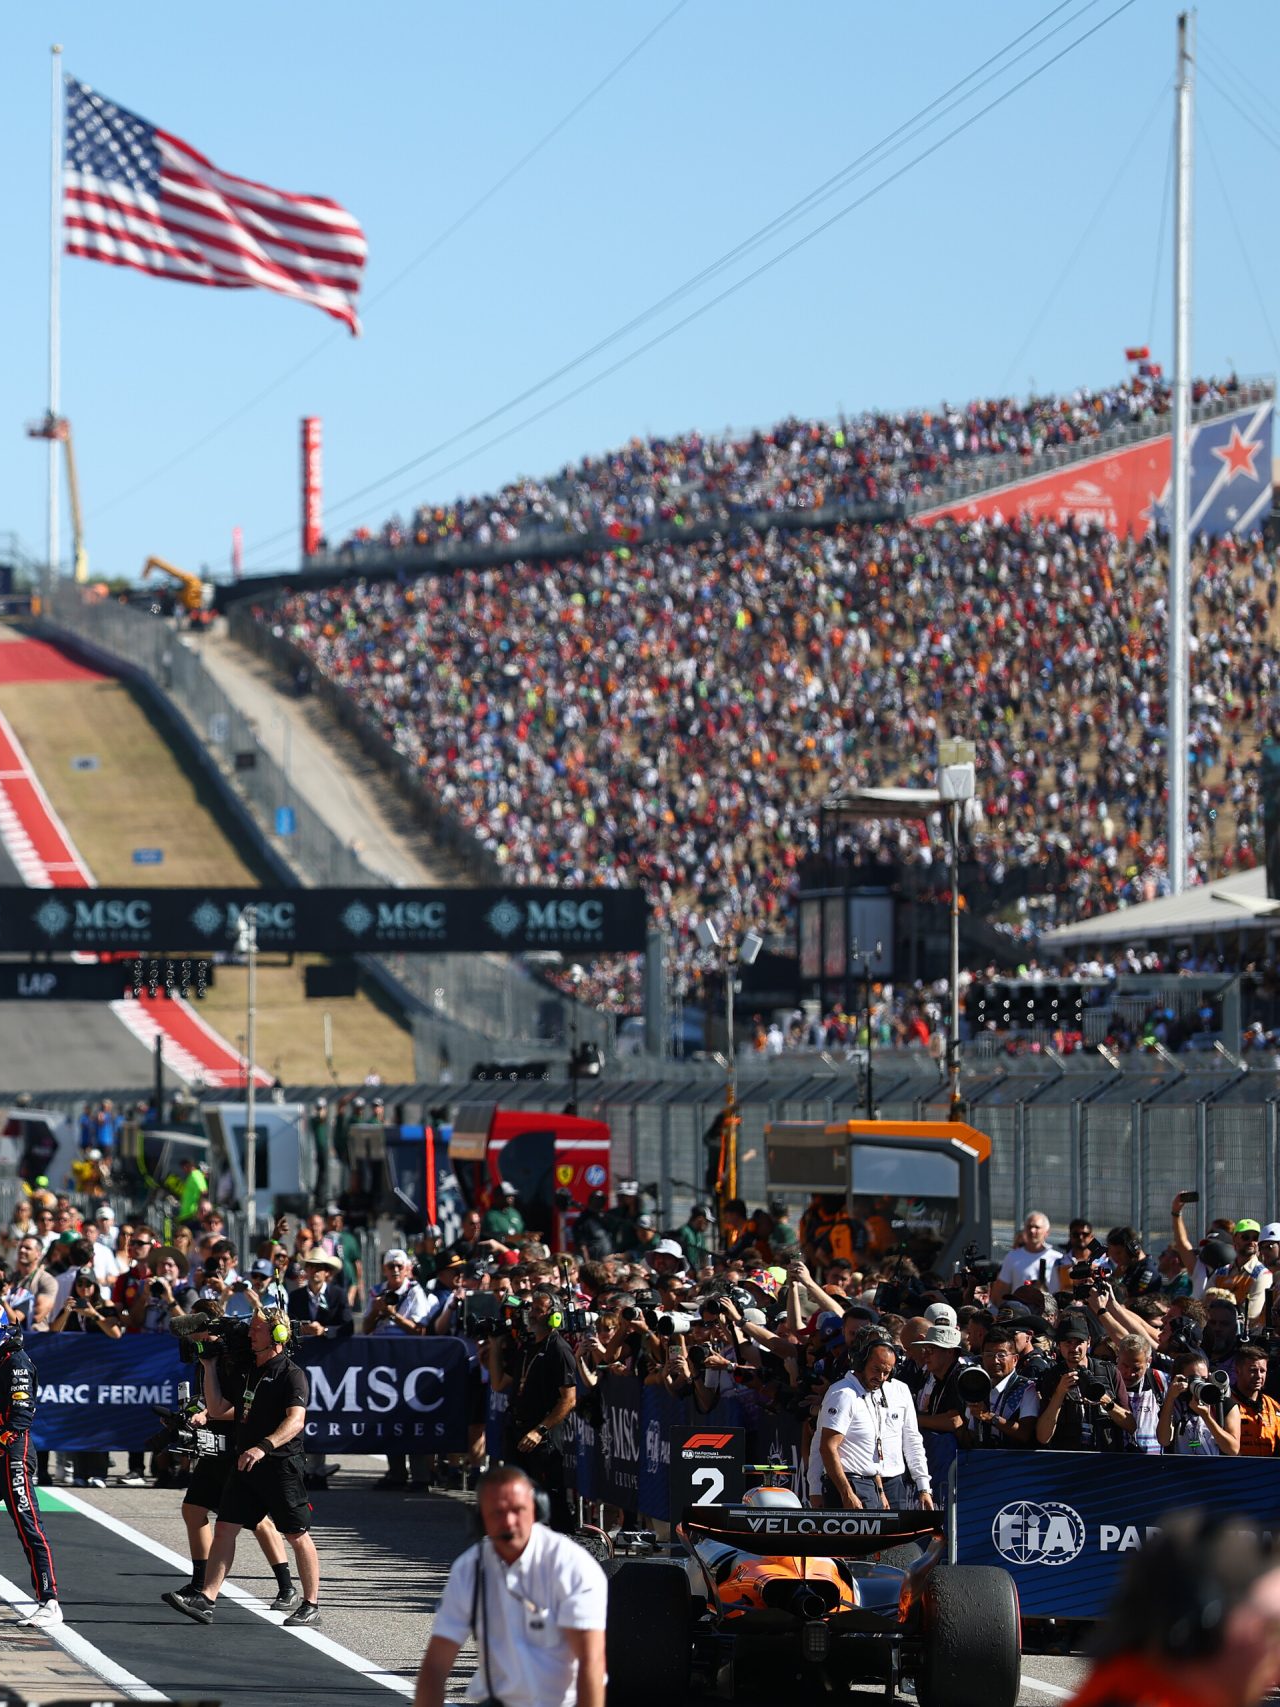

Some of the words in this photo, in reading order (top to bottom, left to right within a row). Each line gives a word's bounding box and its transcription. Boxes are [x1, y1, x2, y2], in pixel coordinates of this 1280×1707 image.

[74, 899, 152, 928] MSC
[376, 902, 447, 930] MSC
[525, 900, 604, 930] MSC
[18, 973, 57, 996] LAP
[13, 1368, 29, 1376] VISA
[98, 1380, 173, 1405] FERMÉ
[306, 1365, 446, 1413] MSC
[306, 1423, 446, 1437] CRUISES
[611, 1406, 640, 1463] MSC
[682, 1450, 694, 1459] FIA
[10, 1460, 25, 1486] Bull
[13, 1486, 31, 1513] Red
[691, 1468, 724, 1507] 2
[747, 1517, 881, 1535] VELO.COM
[999, 1514, 1076, 1551] FIA
[1100, 1524, 1164, 1551] PA
